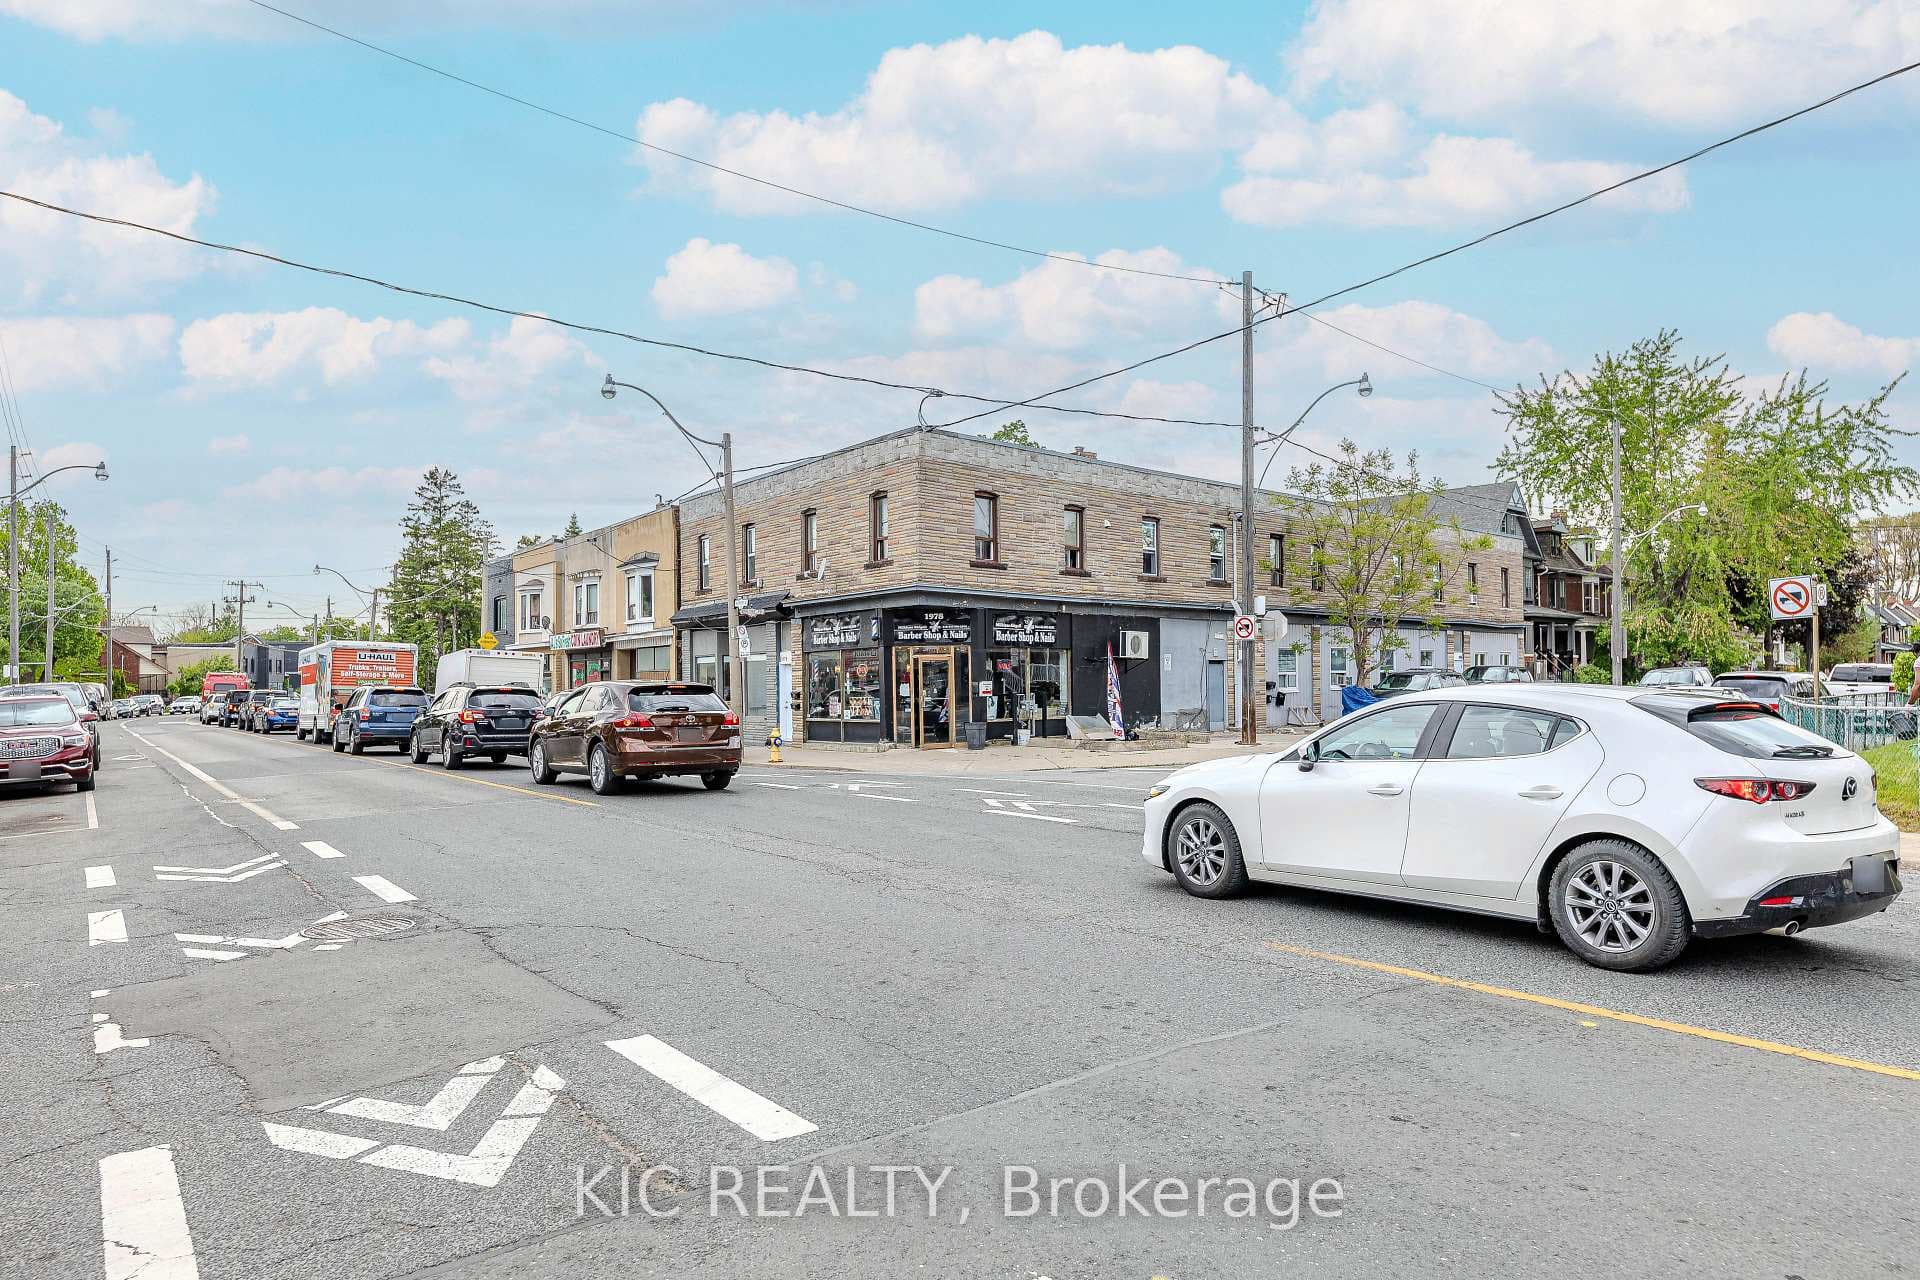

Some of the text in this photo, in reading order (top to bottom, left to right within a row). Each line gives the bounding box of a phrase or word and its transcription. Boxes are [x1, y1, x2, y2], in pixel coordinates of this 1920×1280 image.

[898, 630, 968, 641] Barber Shop & Nails
[996, 631, 1055, 645] Barber Shop & Nails
